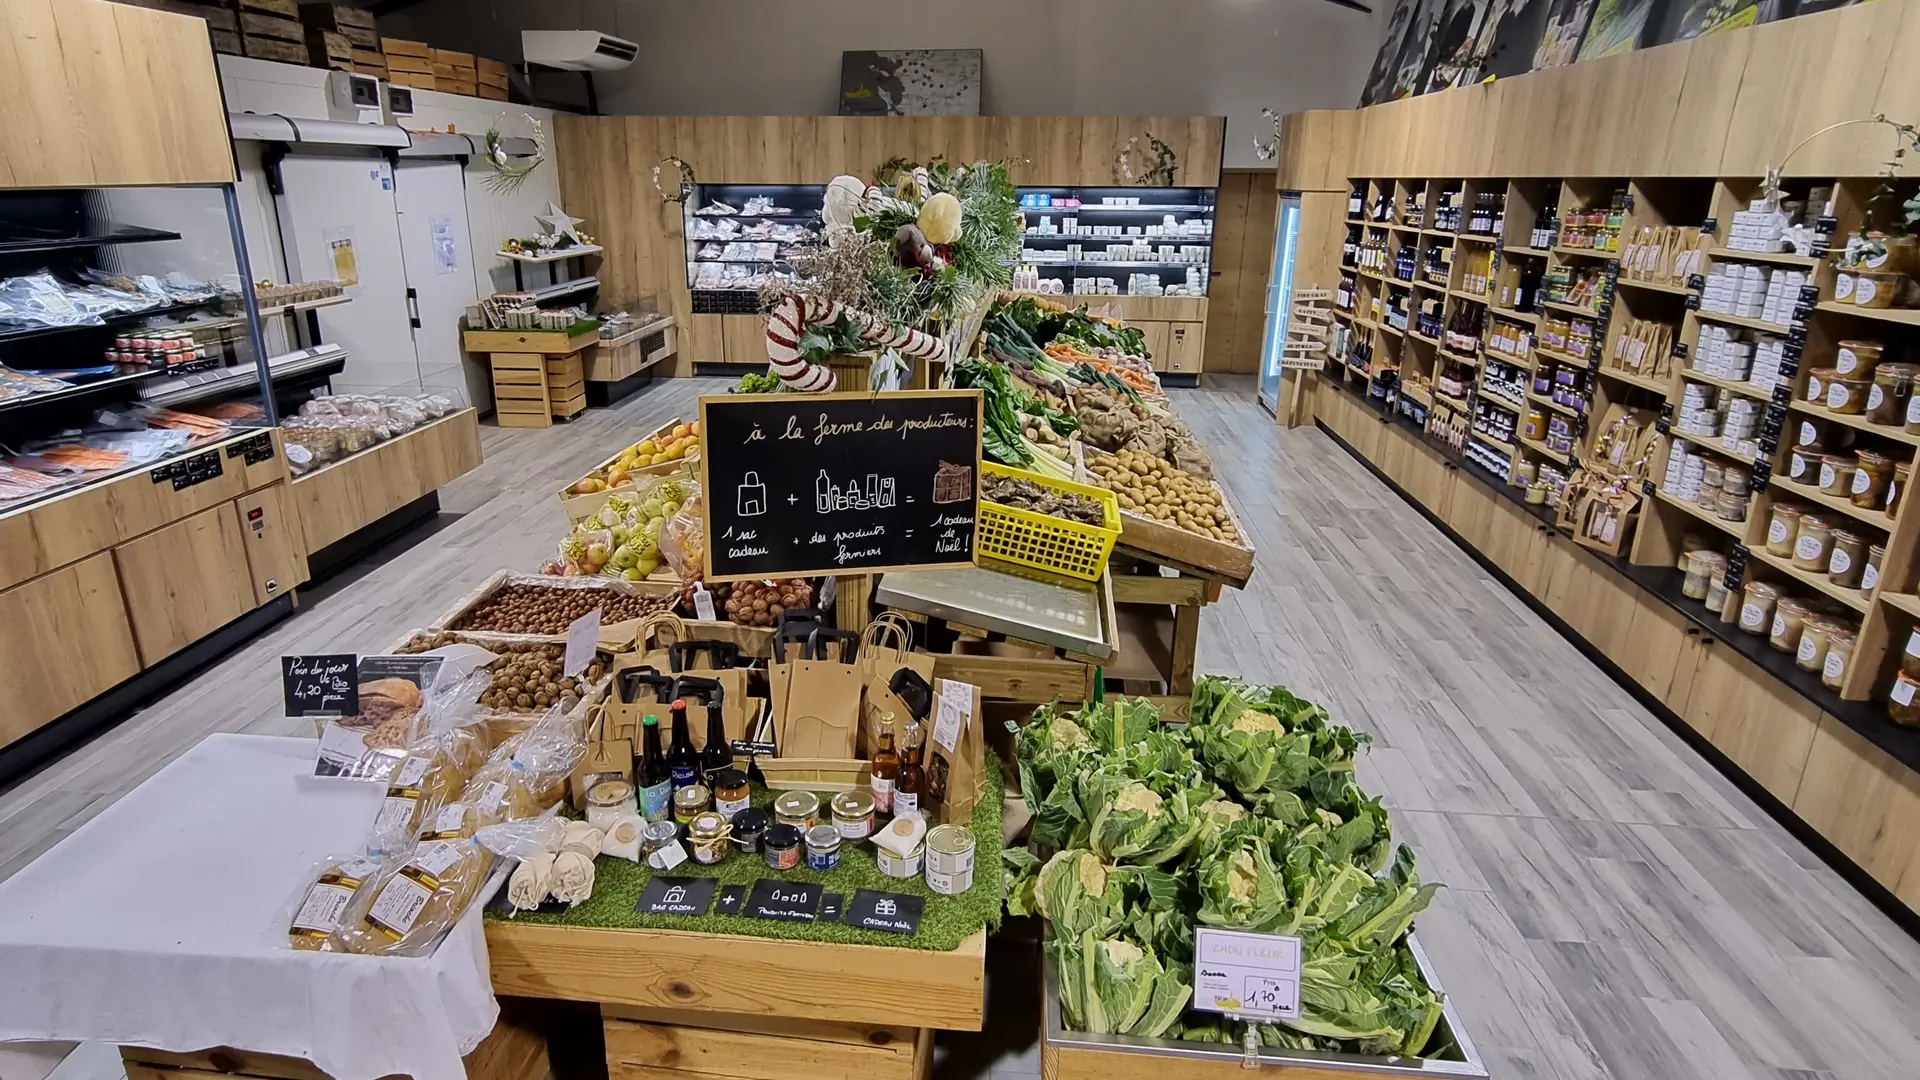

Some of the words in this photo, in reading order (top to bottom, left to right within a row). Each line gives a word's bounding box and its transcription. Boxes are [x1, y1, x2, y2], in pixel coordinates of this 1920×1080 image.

[743, 422, 766, 444] à
[779, 415, 804, 440] la
[813, 413, 863, 445] ferme
[866, 414, 893, 433] des
[943, 515, 974, 526] cadeau
[721, 525, 733, 540] 1
[736, 529, 757, 541] sac
[809, 530, 826, 544] des
[833, 524, 886, 548] produits
[940, 527, 955, 538] de
[728, 544, 769, 559] cadeau
[935, 537, 961, 553] Noël
[834, 548, 882, 564] fermiers
[289, 656, 308, 676] Pain
[320, 660, 349, 684] jour
[294, 679, 321, 699] 4,20
[863, 916, 893, 927] CADEAU
[1213, 943, 1243, 956] CHOU
[1246, 946, 1285, 960] FLEUR
[1244, 989, 1276, 1007] 1,70
